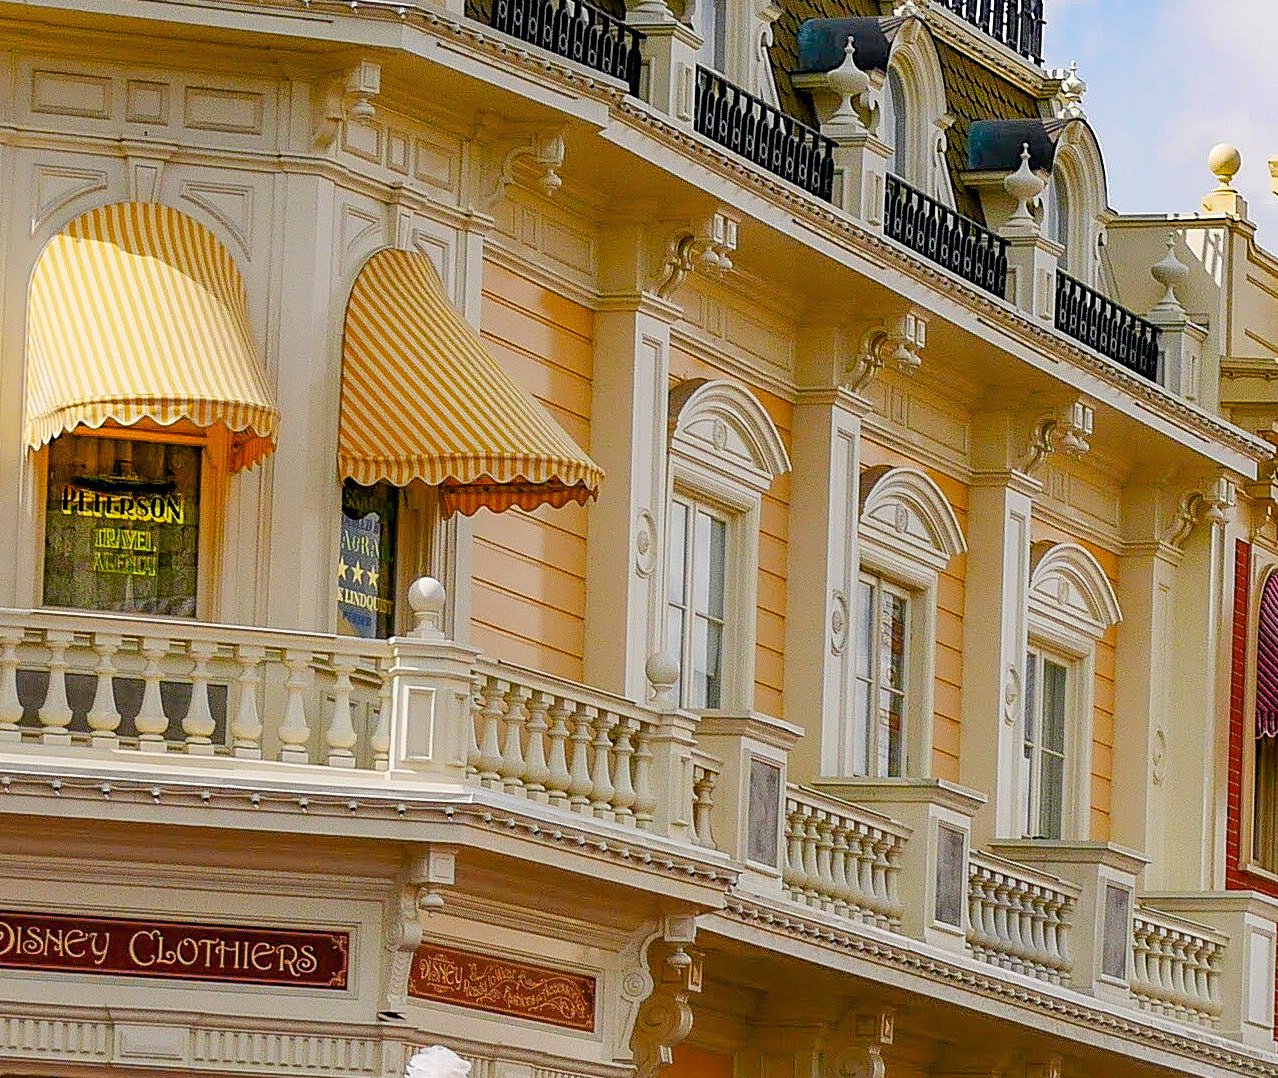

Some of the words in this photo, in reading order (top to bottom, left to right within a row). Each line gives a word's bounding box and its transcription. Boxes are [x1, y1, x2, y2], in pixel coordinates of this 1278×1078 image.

[61, 485, 185, 525] PETERSON
[94, 527, 157, 552] TRAVEL
[0, 921, 110, 965] DISNEY
[129, 930, 318, 977] CLOTHIERS
